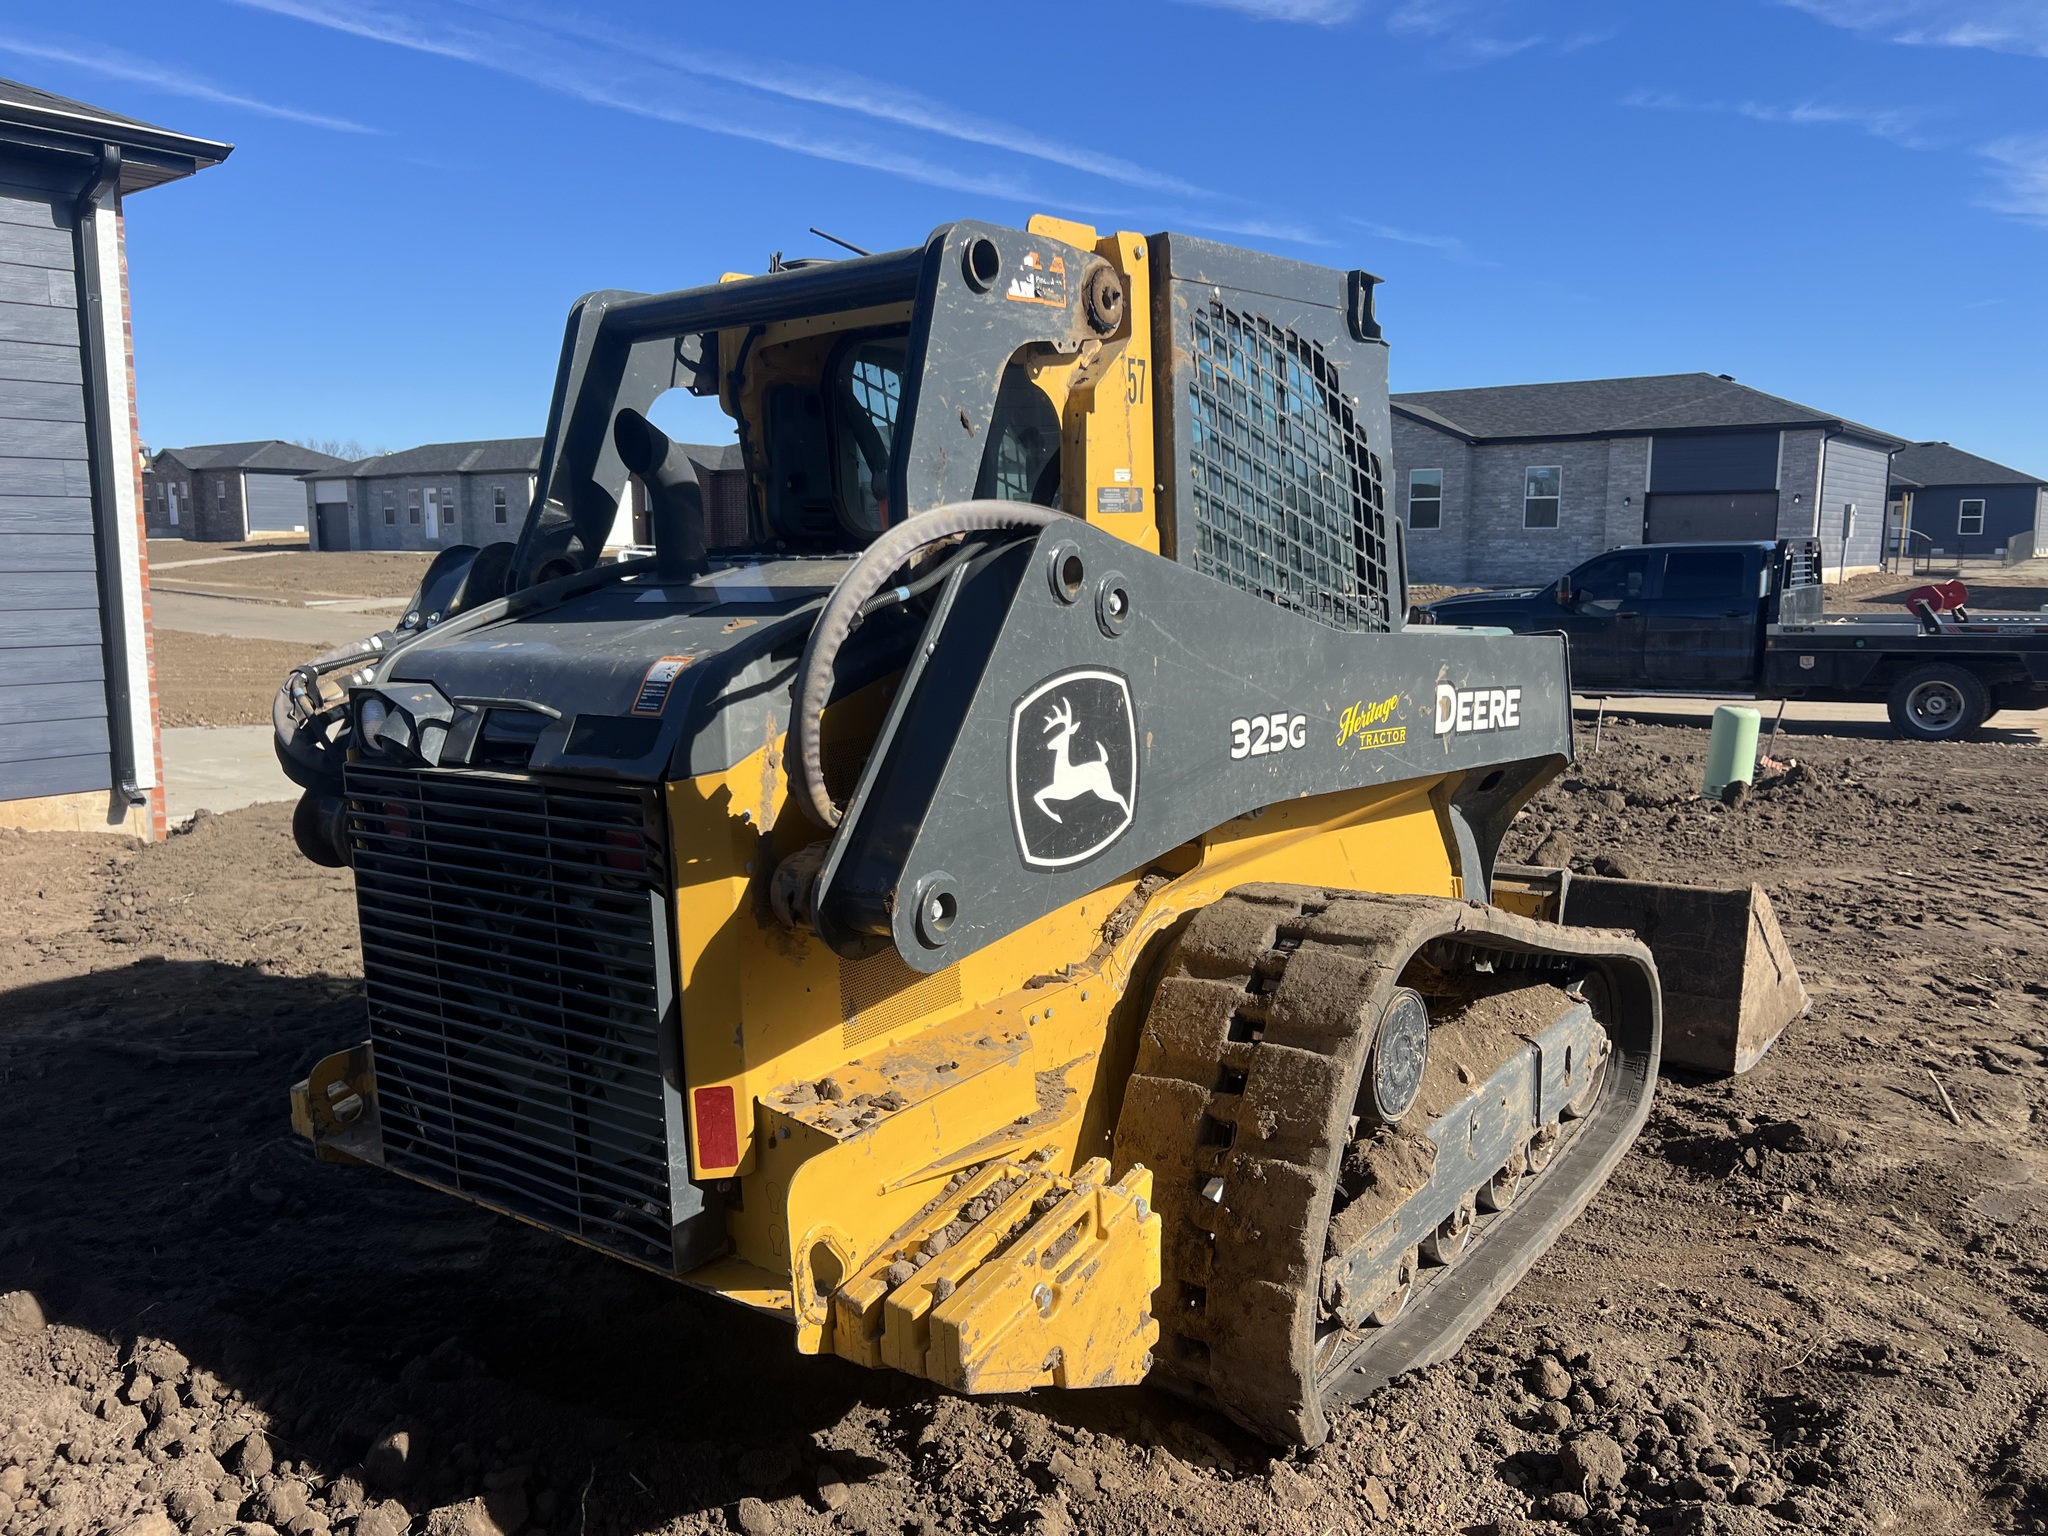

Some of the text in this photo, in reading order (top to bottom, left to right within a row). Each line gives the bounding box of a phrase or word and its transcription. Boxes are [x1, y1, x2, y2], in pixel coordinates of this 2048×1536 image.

[1128, 358, 1146, 404] 57
[1337, 695, 1398, 746] Heritage
[1434, 683, 1521, 735] DEERE
[1230, 711, 1307, 760] 325G
[1360, 730, 1406, 746] TRACTOR
